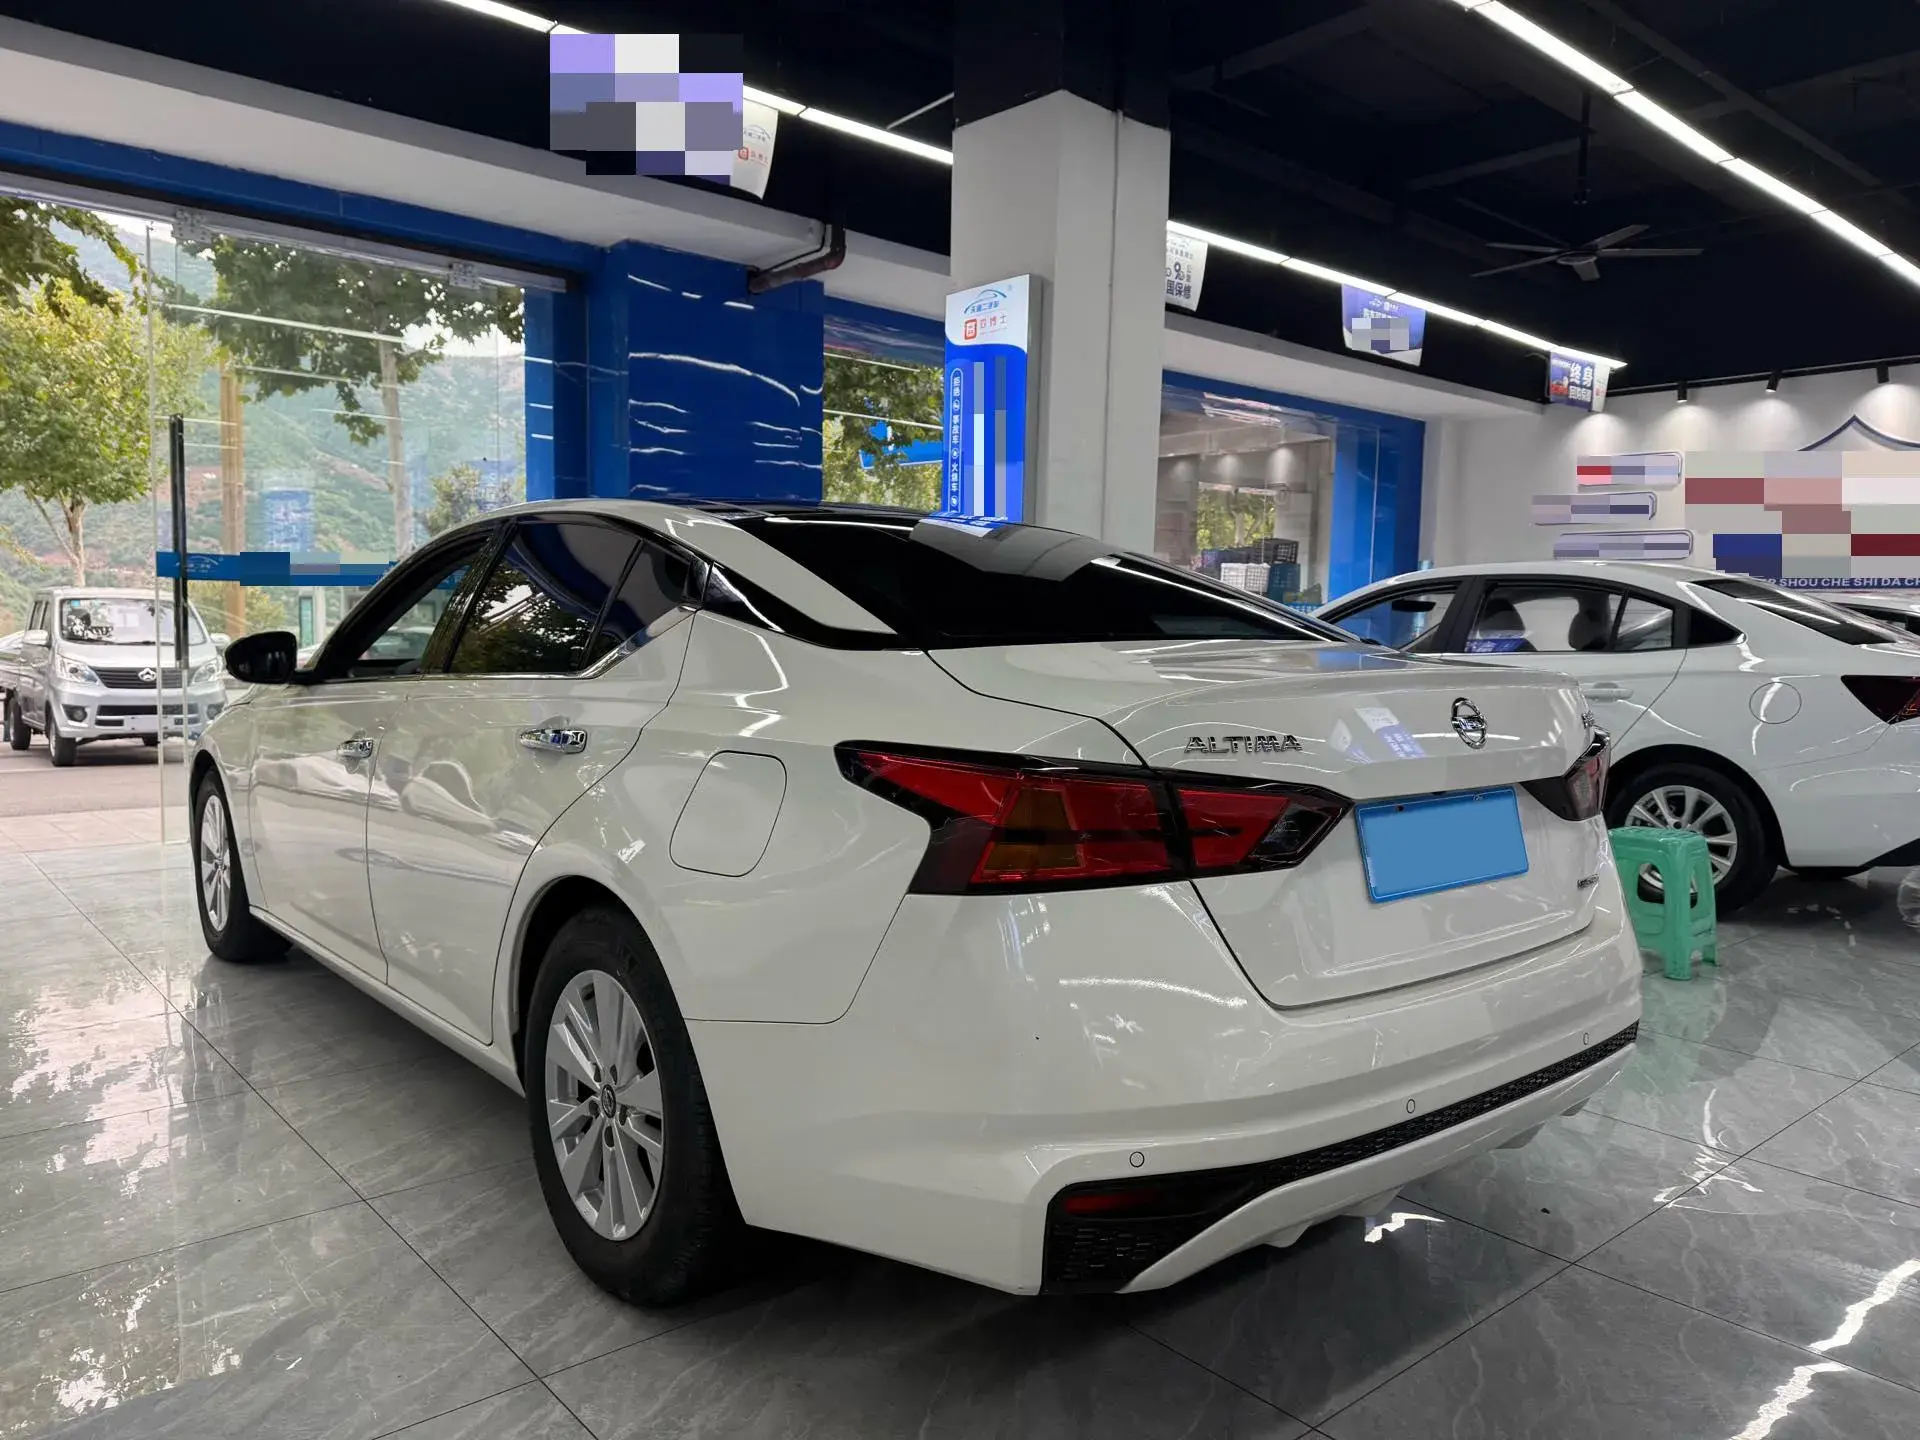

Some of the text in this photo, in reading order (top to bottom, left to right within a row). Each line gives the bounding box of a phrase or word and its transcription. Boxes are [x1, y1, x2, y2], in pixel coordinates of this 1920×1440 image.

[1779, 578, 1819, 587] SHOU
[1821, 578, 1850, 587] CHE
[1854, 578, 1878, 587] SHI
[1881, 577, 1901, 586] DA
[1184, 734, 1303, 754] ALTIMA
